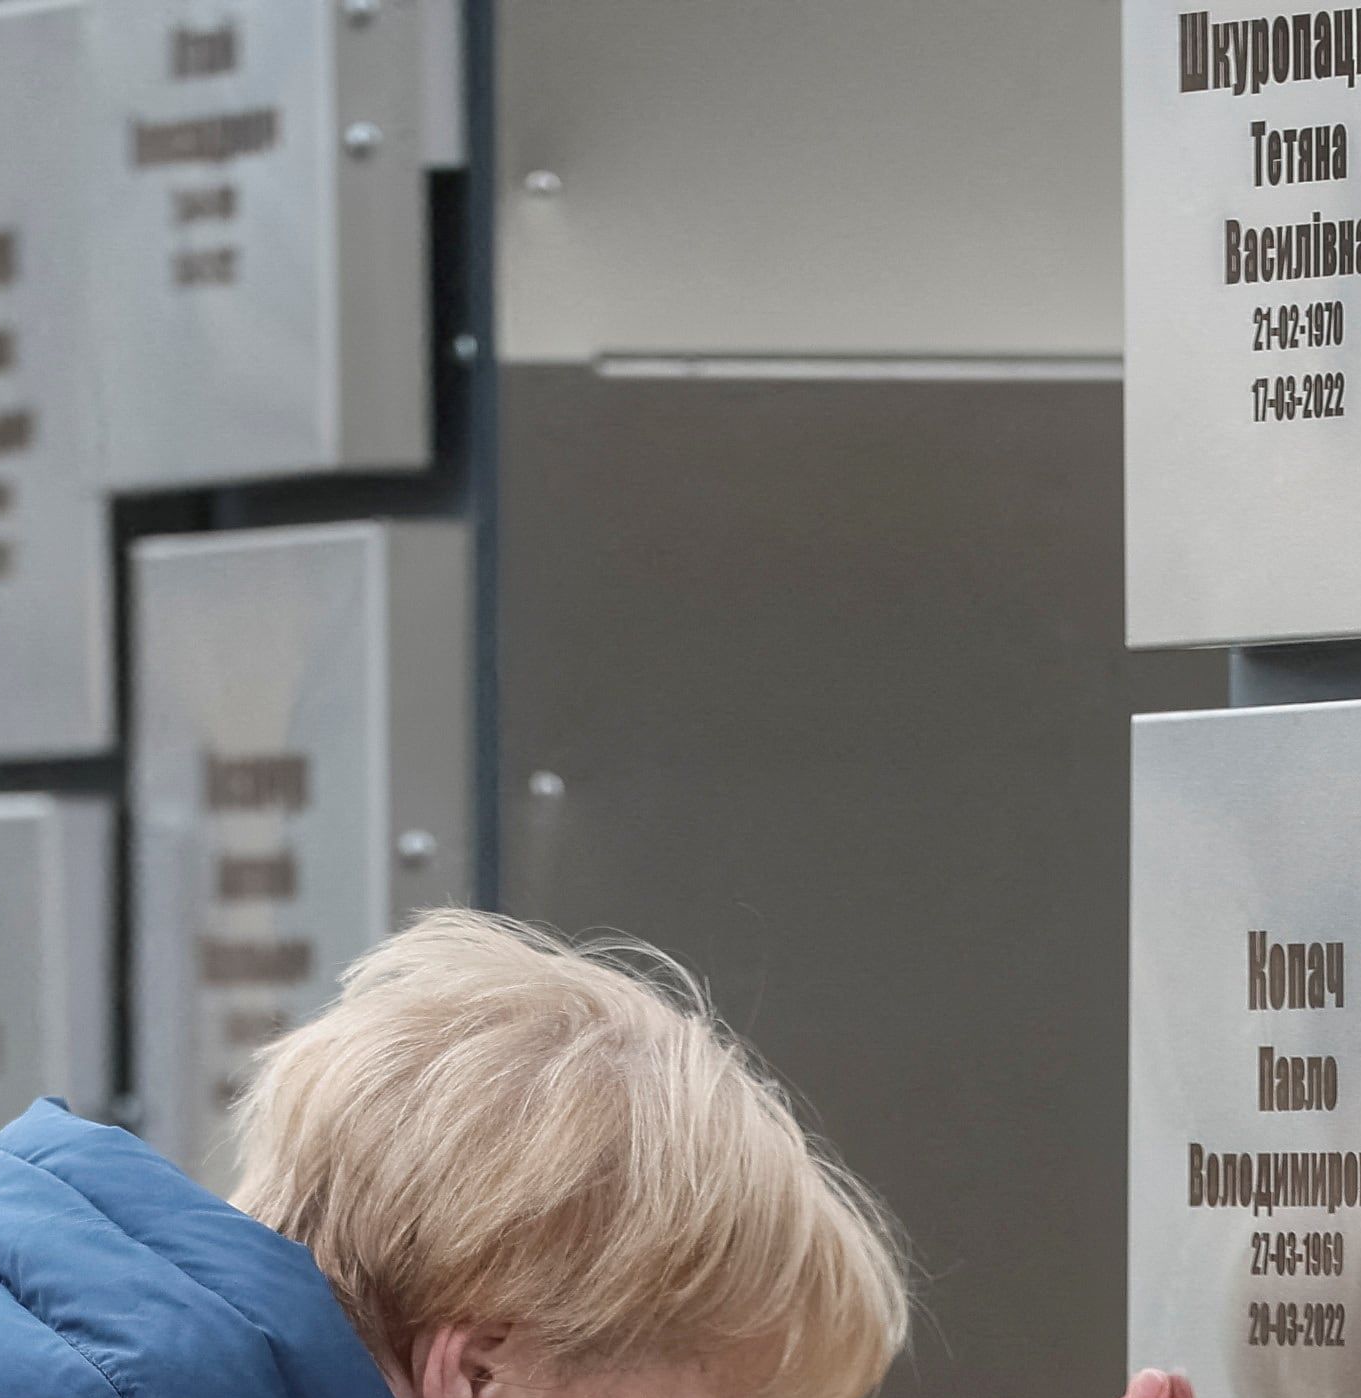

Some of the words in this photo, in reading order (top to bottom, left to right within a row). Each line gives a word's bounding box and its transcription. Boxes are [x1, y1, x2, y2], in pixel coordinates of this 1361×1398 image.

[1250, 121, 1348, 187] Тетяна
[1252, 301, 1344, 352] 21-02-1970
[1251, 372, 1345, 423] 17-03-2022
[1247, 930, 1345, 1011] Копач
[1258, 1045, 1339, 1112] Павло
[1250, 1231, 1344, 1277] 27-03-1969
